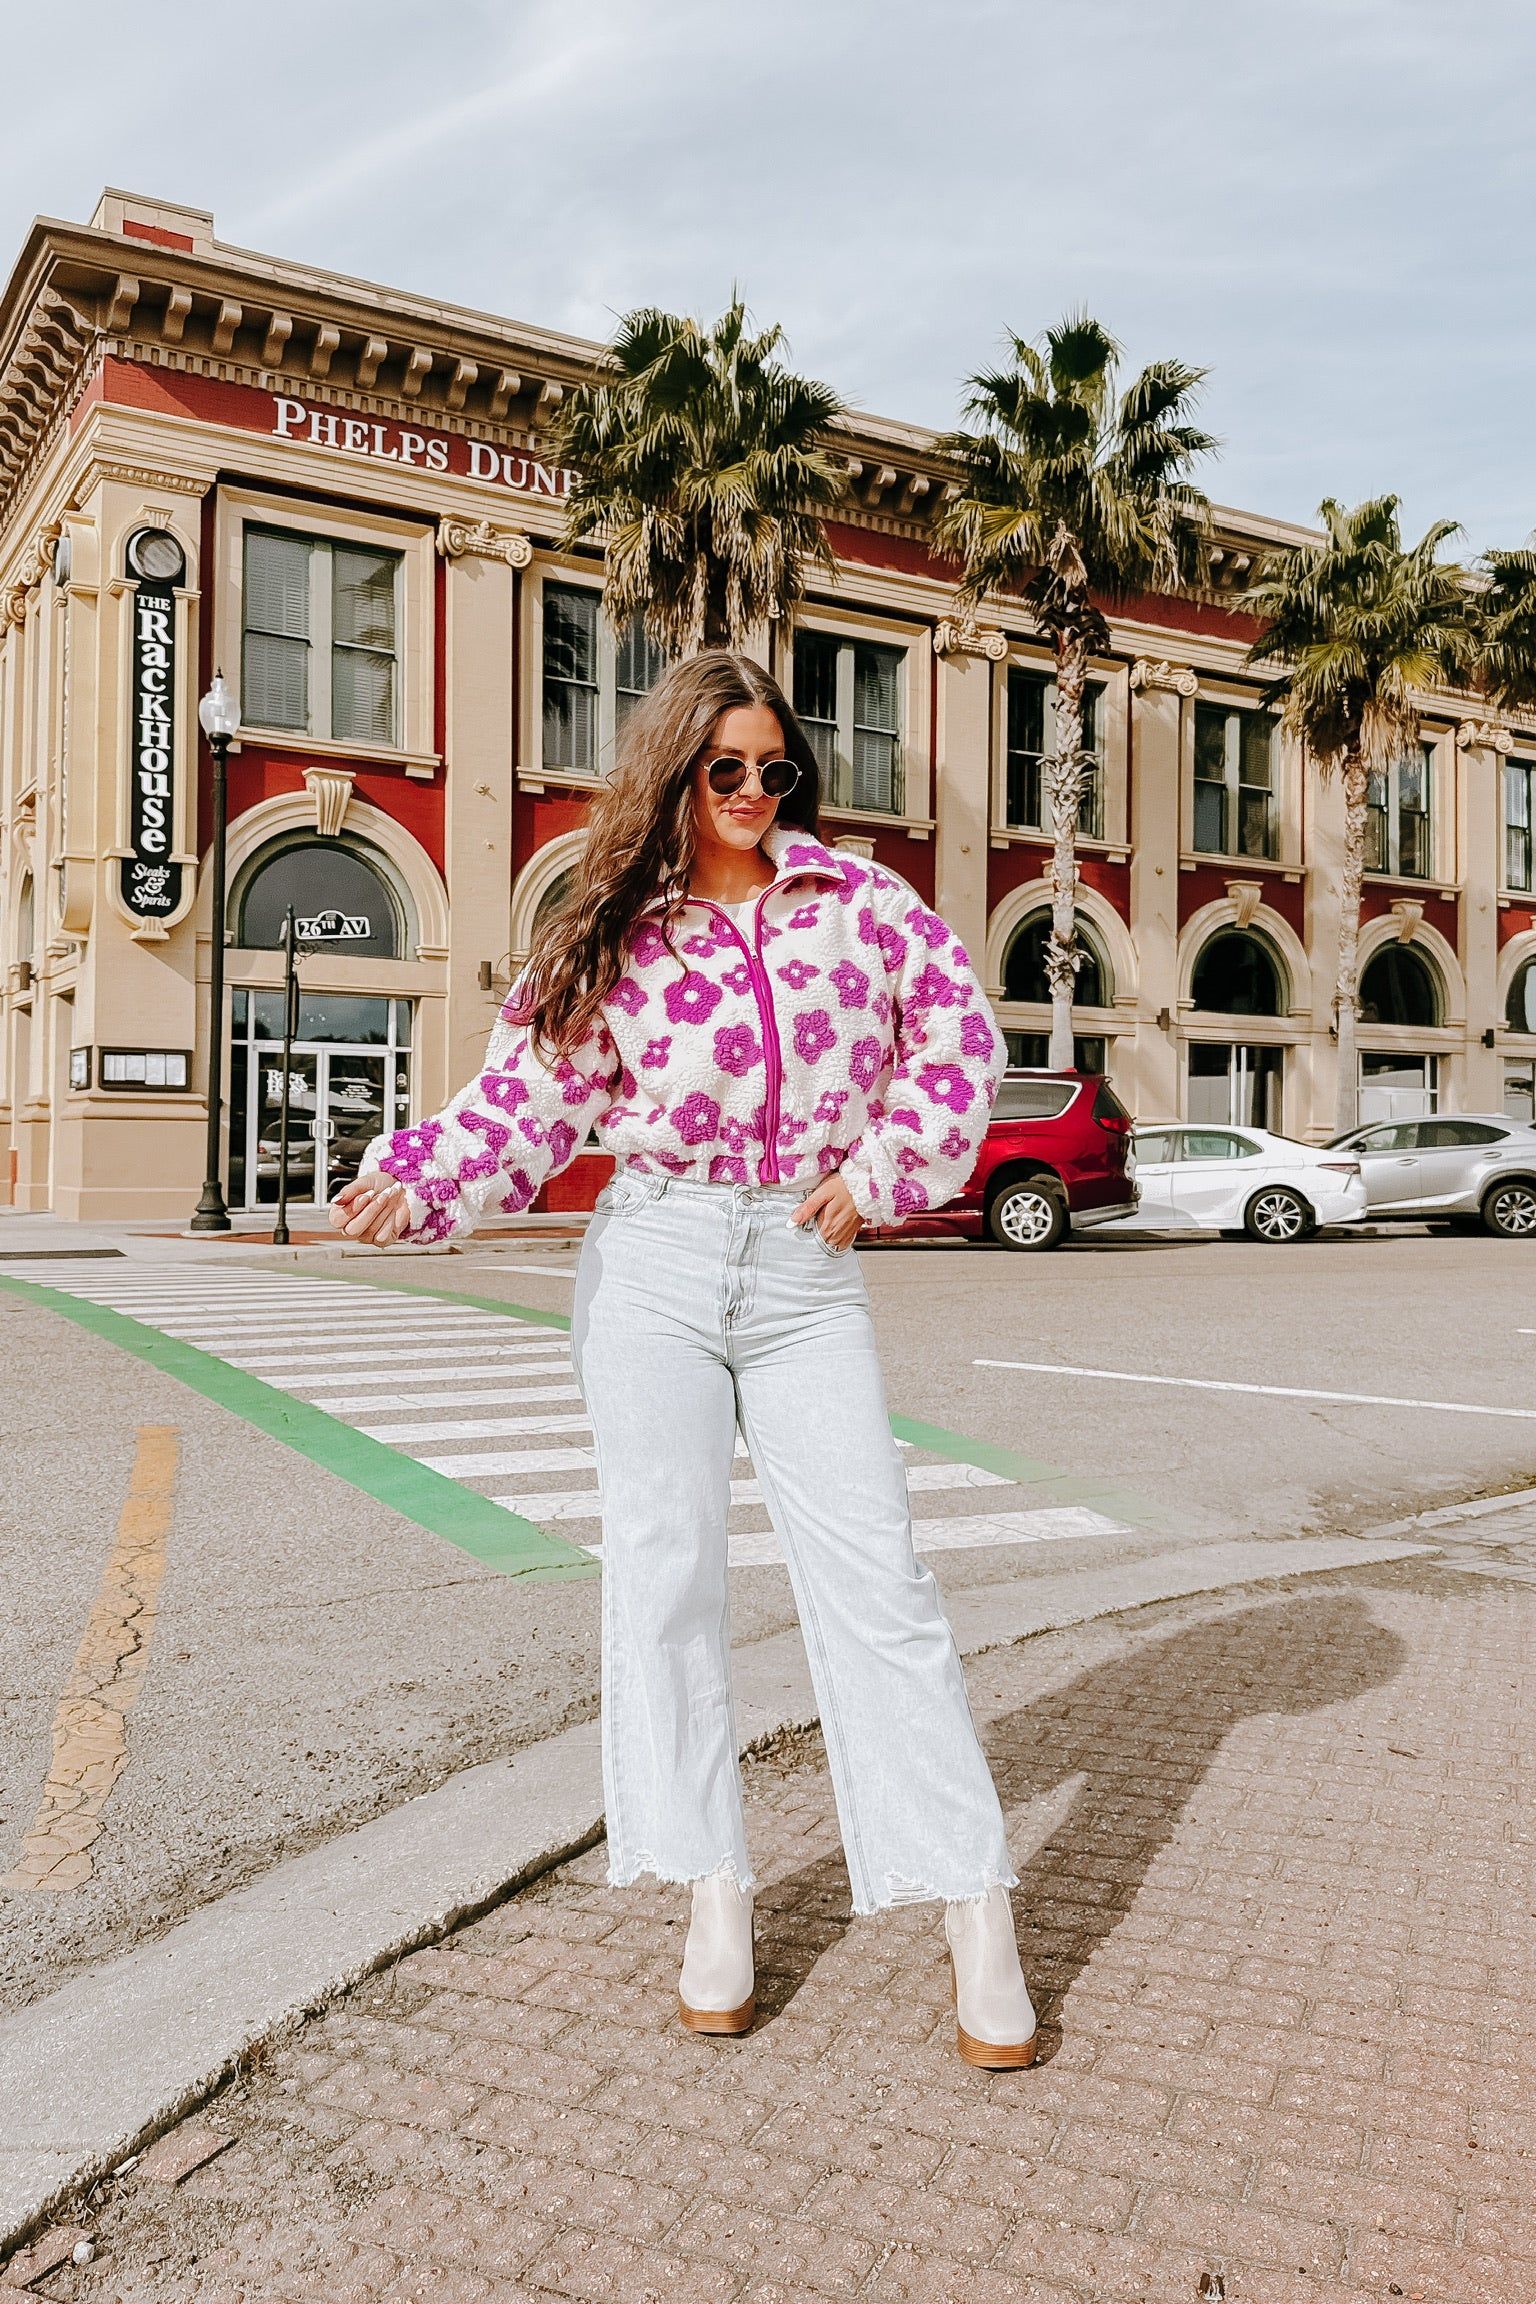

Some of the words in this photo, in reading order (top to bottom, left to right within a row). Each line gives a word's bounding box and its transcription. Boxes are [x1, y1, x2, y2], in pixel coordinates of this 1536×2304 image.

[272, 396, 448, 471] PHELPS
[136, 594, 171, 611] THE
[131, 862, 171, 880] Steaks
[143, 876, 166, 894] &
[131, 885, 172, 909] Spirits
[339, 919, 365, 936] AV
